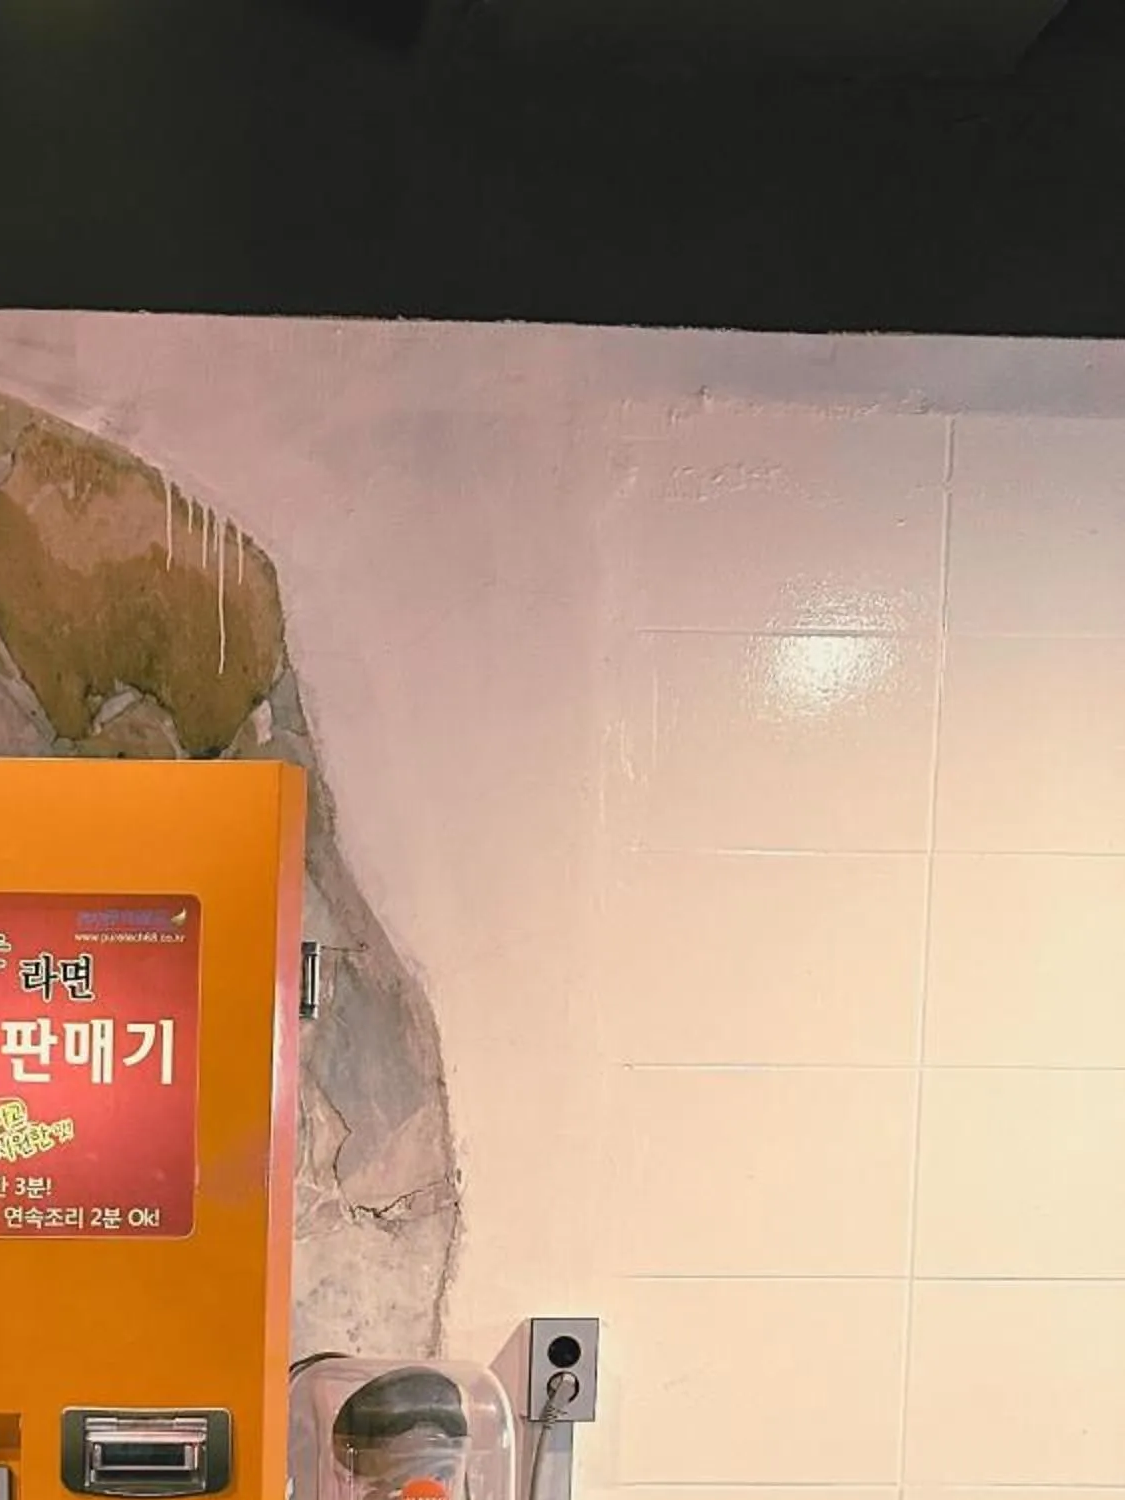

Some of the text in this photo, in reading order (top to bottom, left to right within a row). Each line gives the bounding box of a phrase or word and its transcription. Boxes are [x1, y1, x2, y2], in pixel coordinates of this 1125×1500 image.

[19, 952, 94, 1002] 라면
[14, 1177, 52, 1199] 3분!
[4, 1206, 84, 1229] 연속조리
[90, 1207, 123, 1229] 2분
